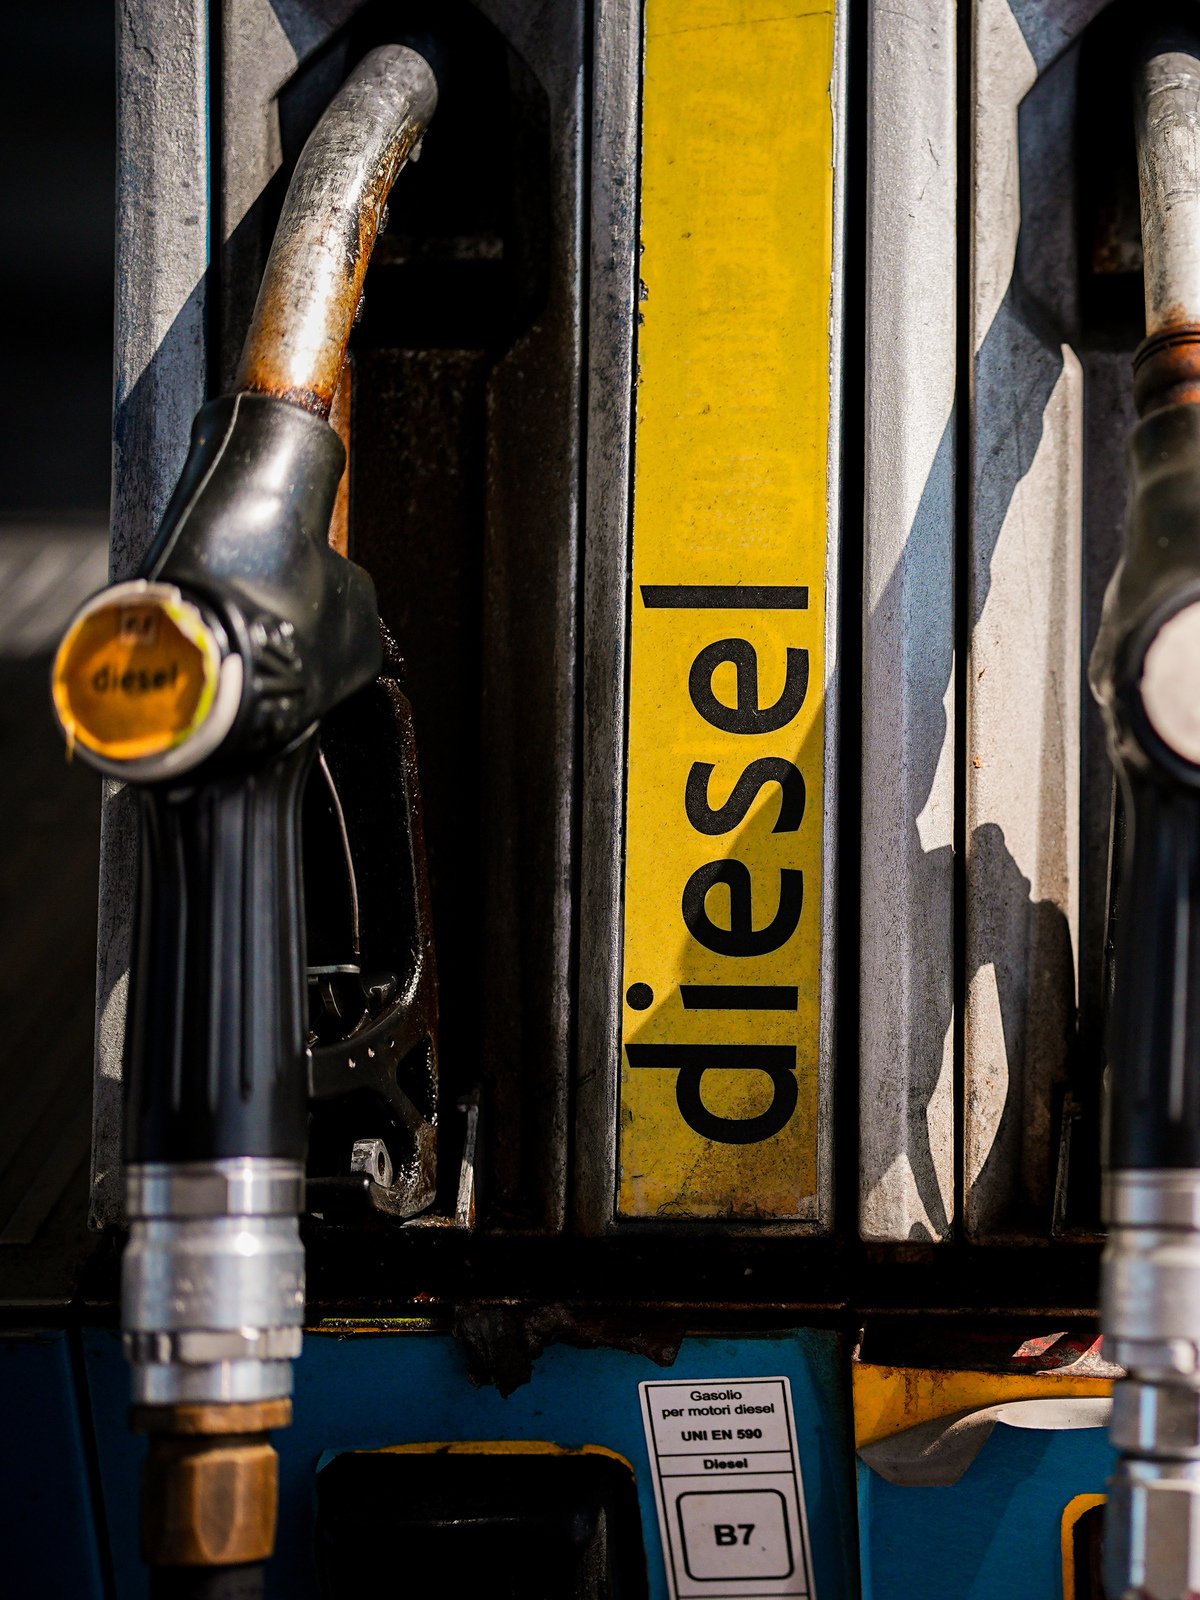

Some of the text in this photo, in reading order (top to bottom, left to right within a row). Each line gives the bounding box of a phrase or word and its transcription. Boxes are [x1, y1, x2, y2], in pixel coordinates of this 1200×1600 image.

[626, 585, 810, 1145] diesel
[690, 1390, 742, 1401] Gasolio
[662, 1403, 775, 1420] per motori diesel
[681, 1428, 762, 1441] UNI EN 590
[703, 1458, 748, 1469] Diesel
[714, 1524, 755, 1546] B7
